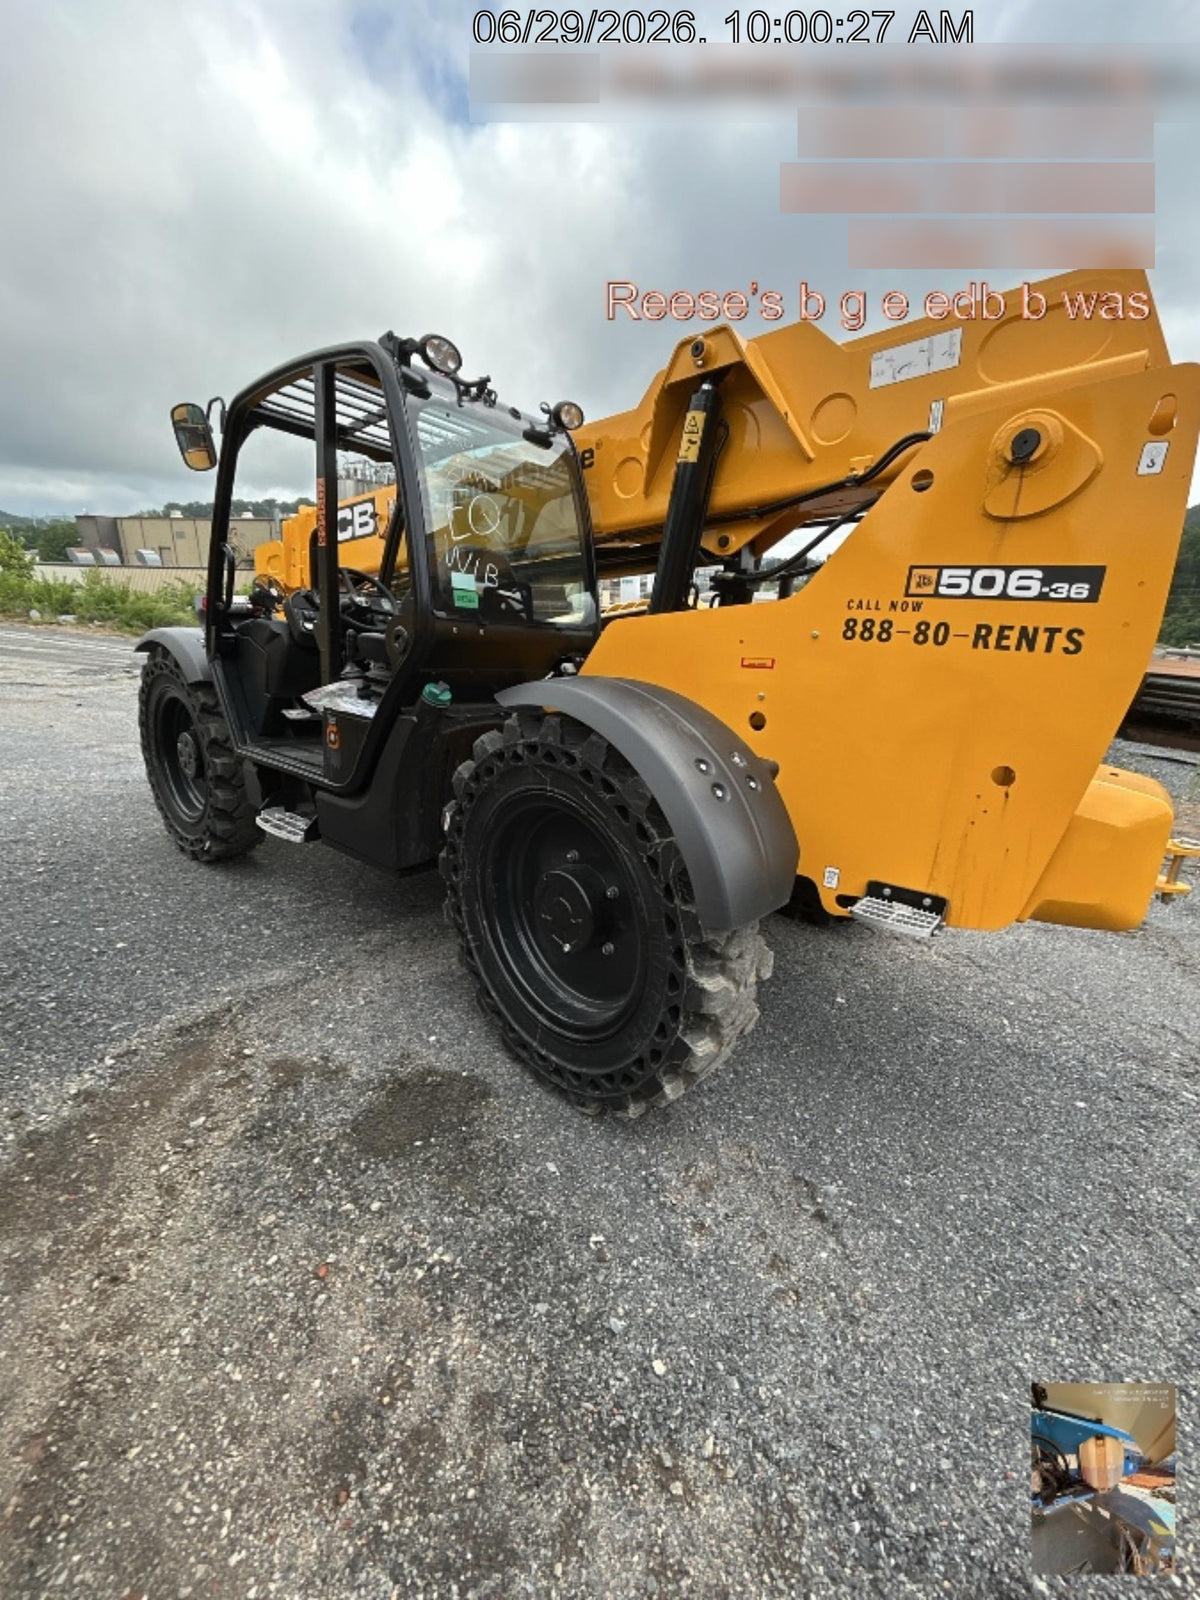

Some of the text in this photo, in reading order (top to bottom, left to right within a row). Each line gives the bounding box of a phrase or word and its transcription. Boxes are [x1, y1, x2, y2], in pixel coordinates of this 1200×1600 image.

[338, 502, 375, 541] CB
[938, 568, 1090, 599] 506-36
[847, 599, 923, 612] CALL NOW
[842, 618, 1085, 655] 888-80-RENTS
